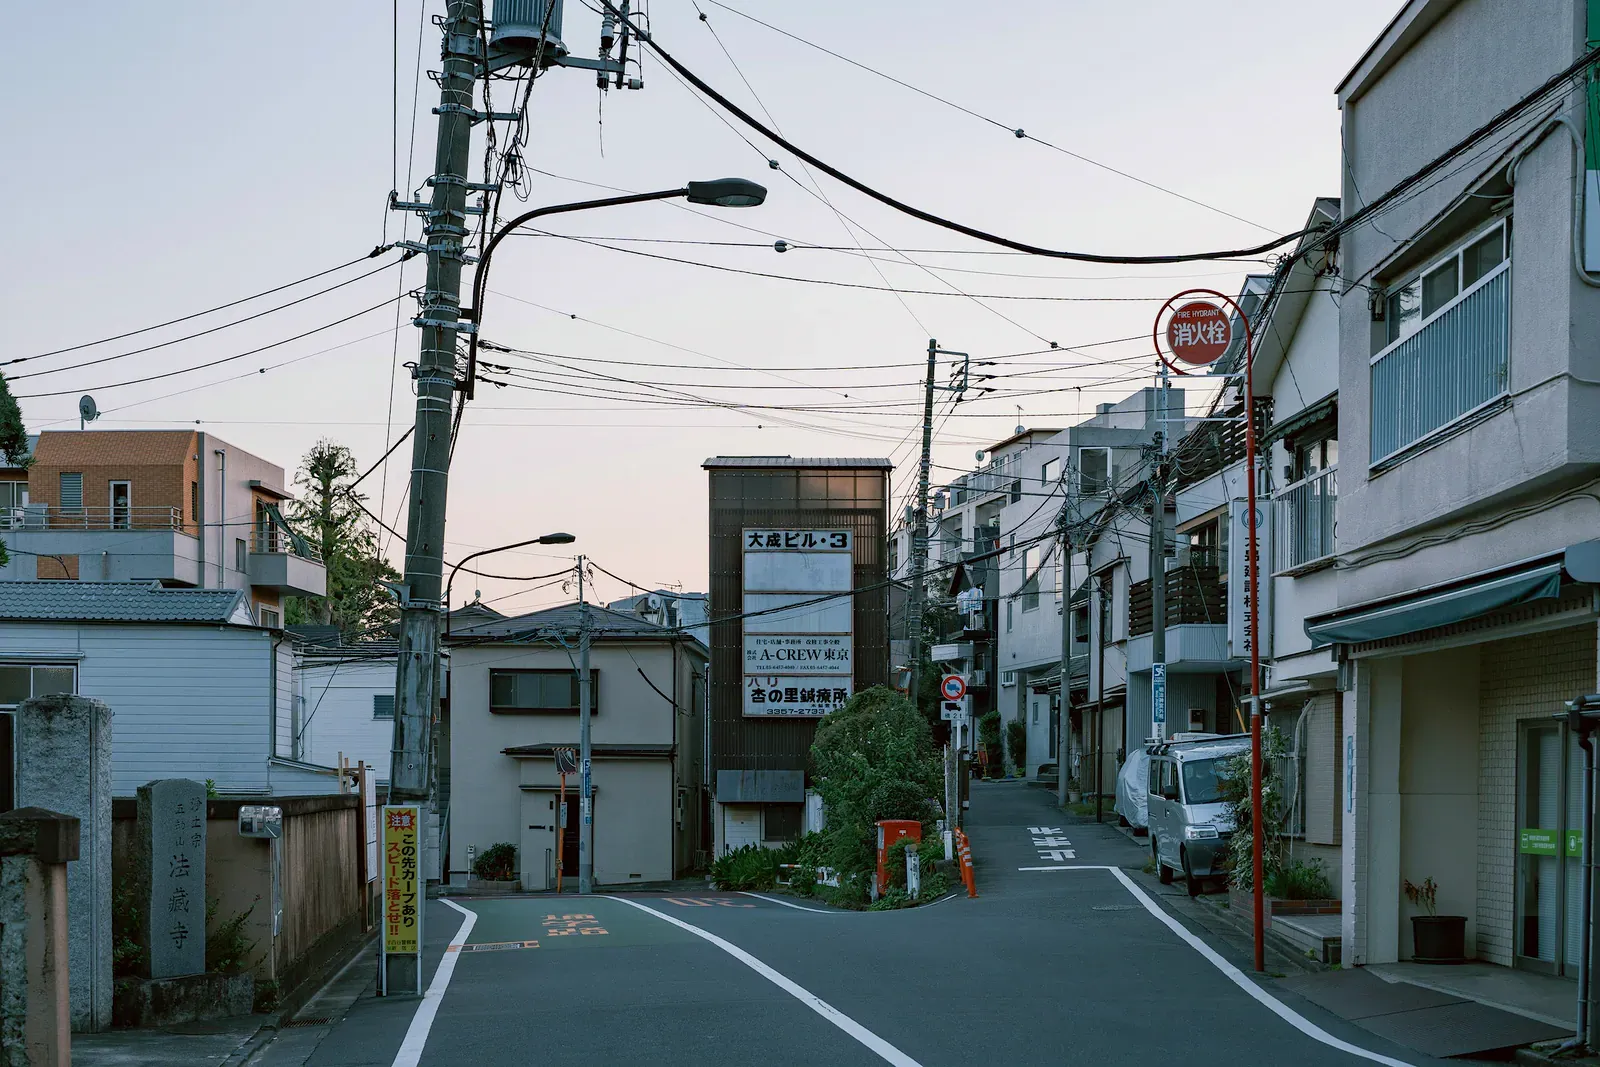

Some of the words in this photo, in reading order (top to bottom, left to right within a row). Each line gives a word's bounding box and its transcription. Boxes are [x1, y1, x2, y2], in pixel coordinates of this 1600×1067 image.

[1192, 309, 1219, 318] HYDRANT
[1173, 320, 1227, 347] 消火栓
[748, 532, 848, 548] 大成ビル・3
[748, 677, 778, 687] ハリ
[391, 815, 411, 827] 注意
[387, 842, 401, 936] スピード落とせ!!
[402, 834, 416, 928] この先カーブあり
